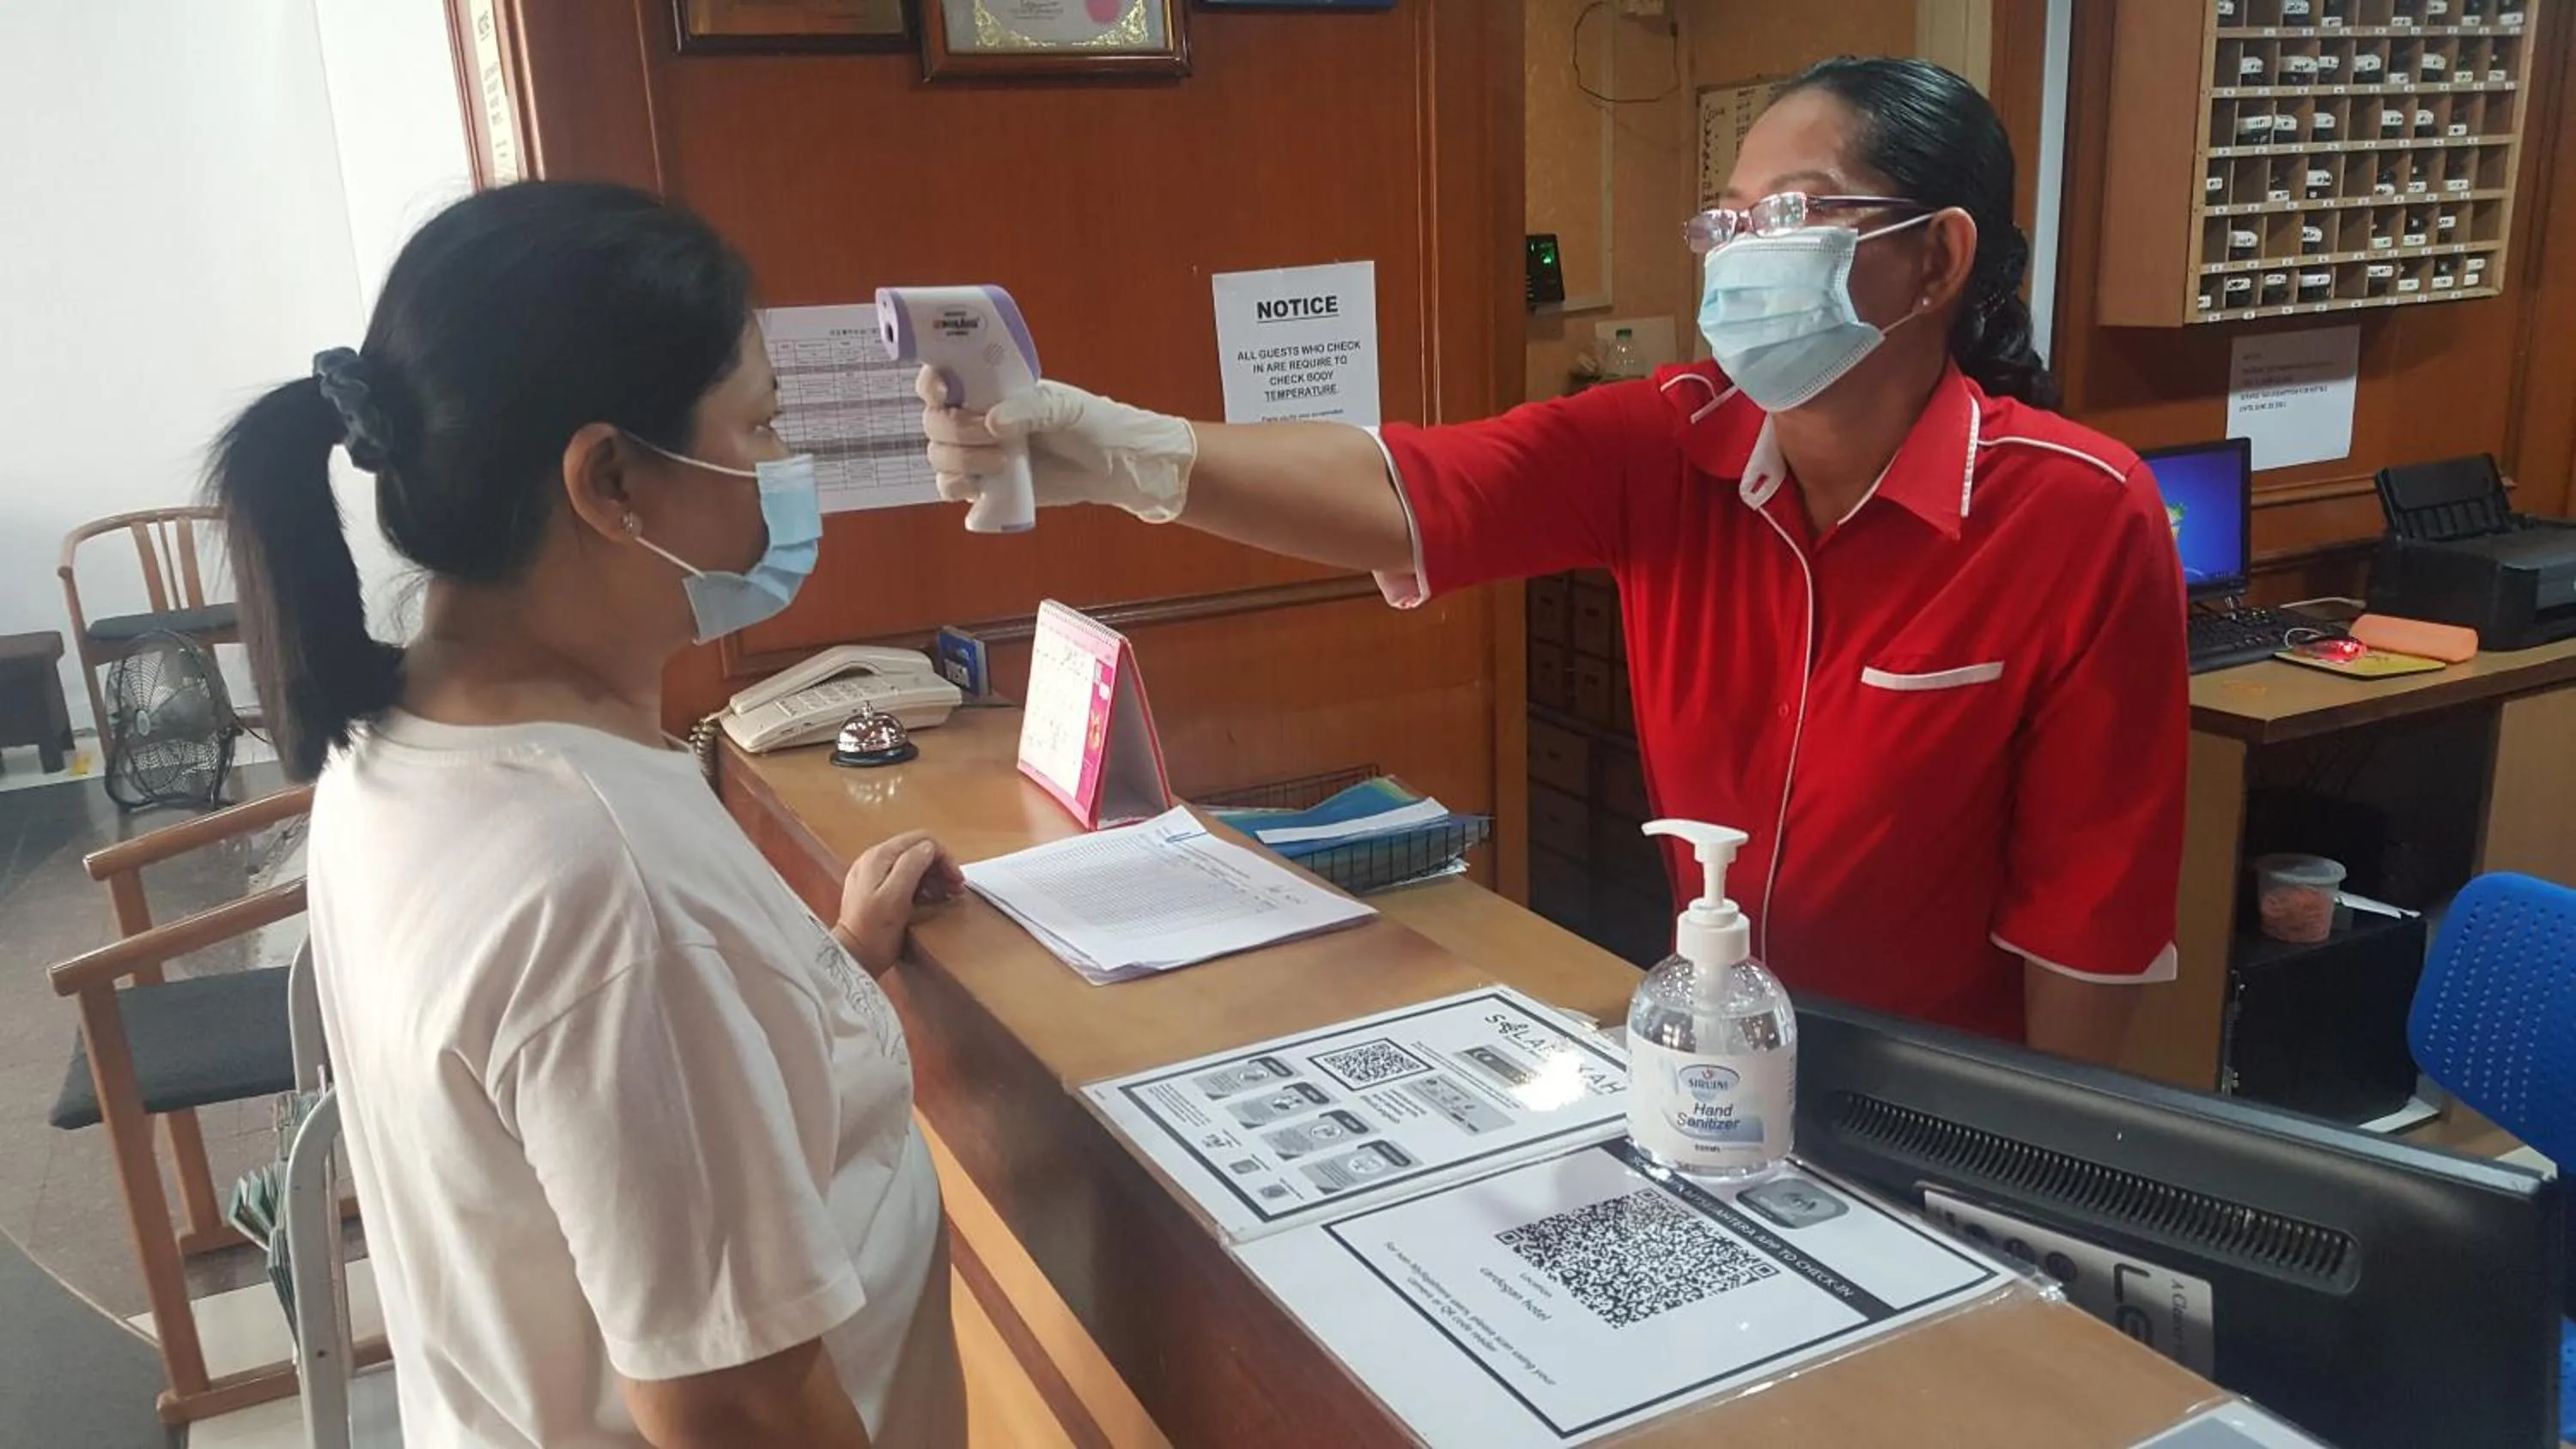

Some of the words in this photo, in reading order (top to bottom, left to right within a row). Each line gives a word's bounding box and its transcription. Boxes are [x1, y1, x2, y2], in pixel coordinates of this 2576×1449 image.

[1256, 295, 1339, 319] NOTICE
[1237, 350, 1257, 361] ALL
[1259, 346, 1299, 359] GUESTS
[1301, 344, 1325, 355] WHO
[1327, 341, 1361, 352] CHECK
[1253, 363, 1264, 373] IN
[1267, 361, 1286, 372] ARE
[1289, 356, 1332, 370] REQUIRE
[1334, 355, 1347, 365] TO
[1269, 373, 1304, 385] CHECK
[1307, 370, 1334, 382] BODY
[1264, 383, 1338, 403] TEMPERATURE
[1693, 1102, 1733, 1118] Hand
[1677, 1112, 1741, 1131] Sanitizer
[1521, 1299, 1552, 1321] hotel
